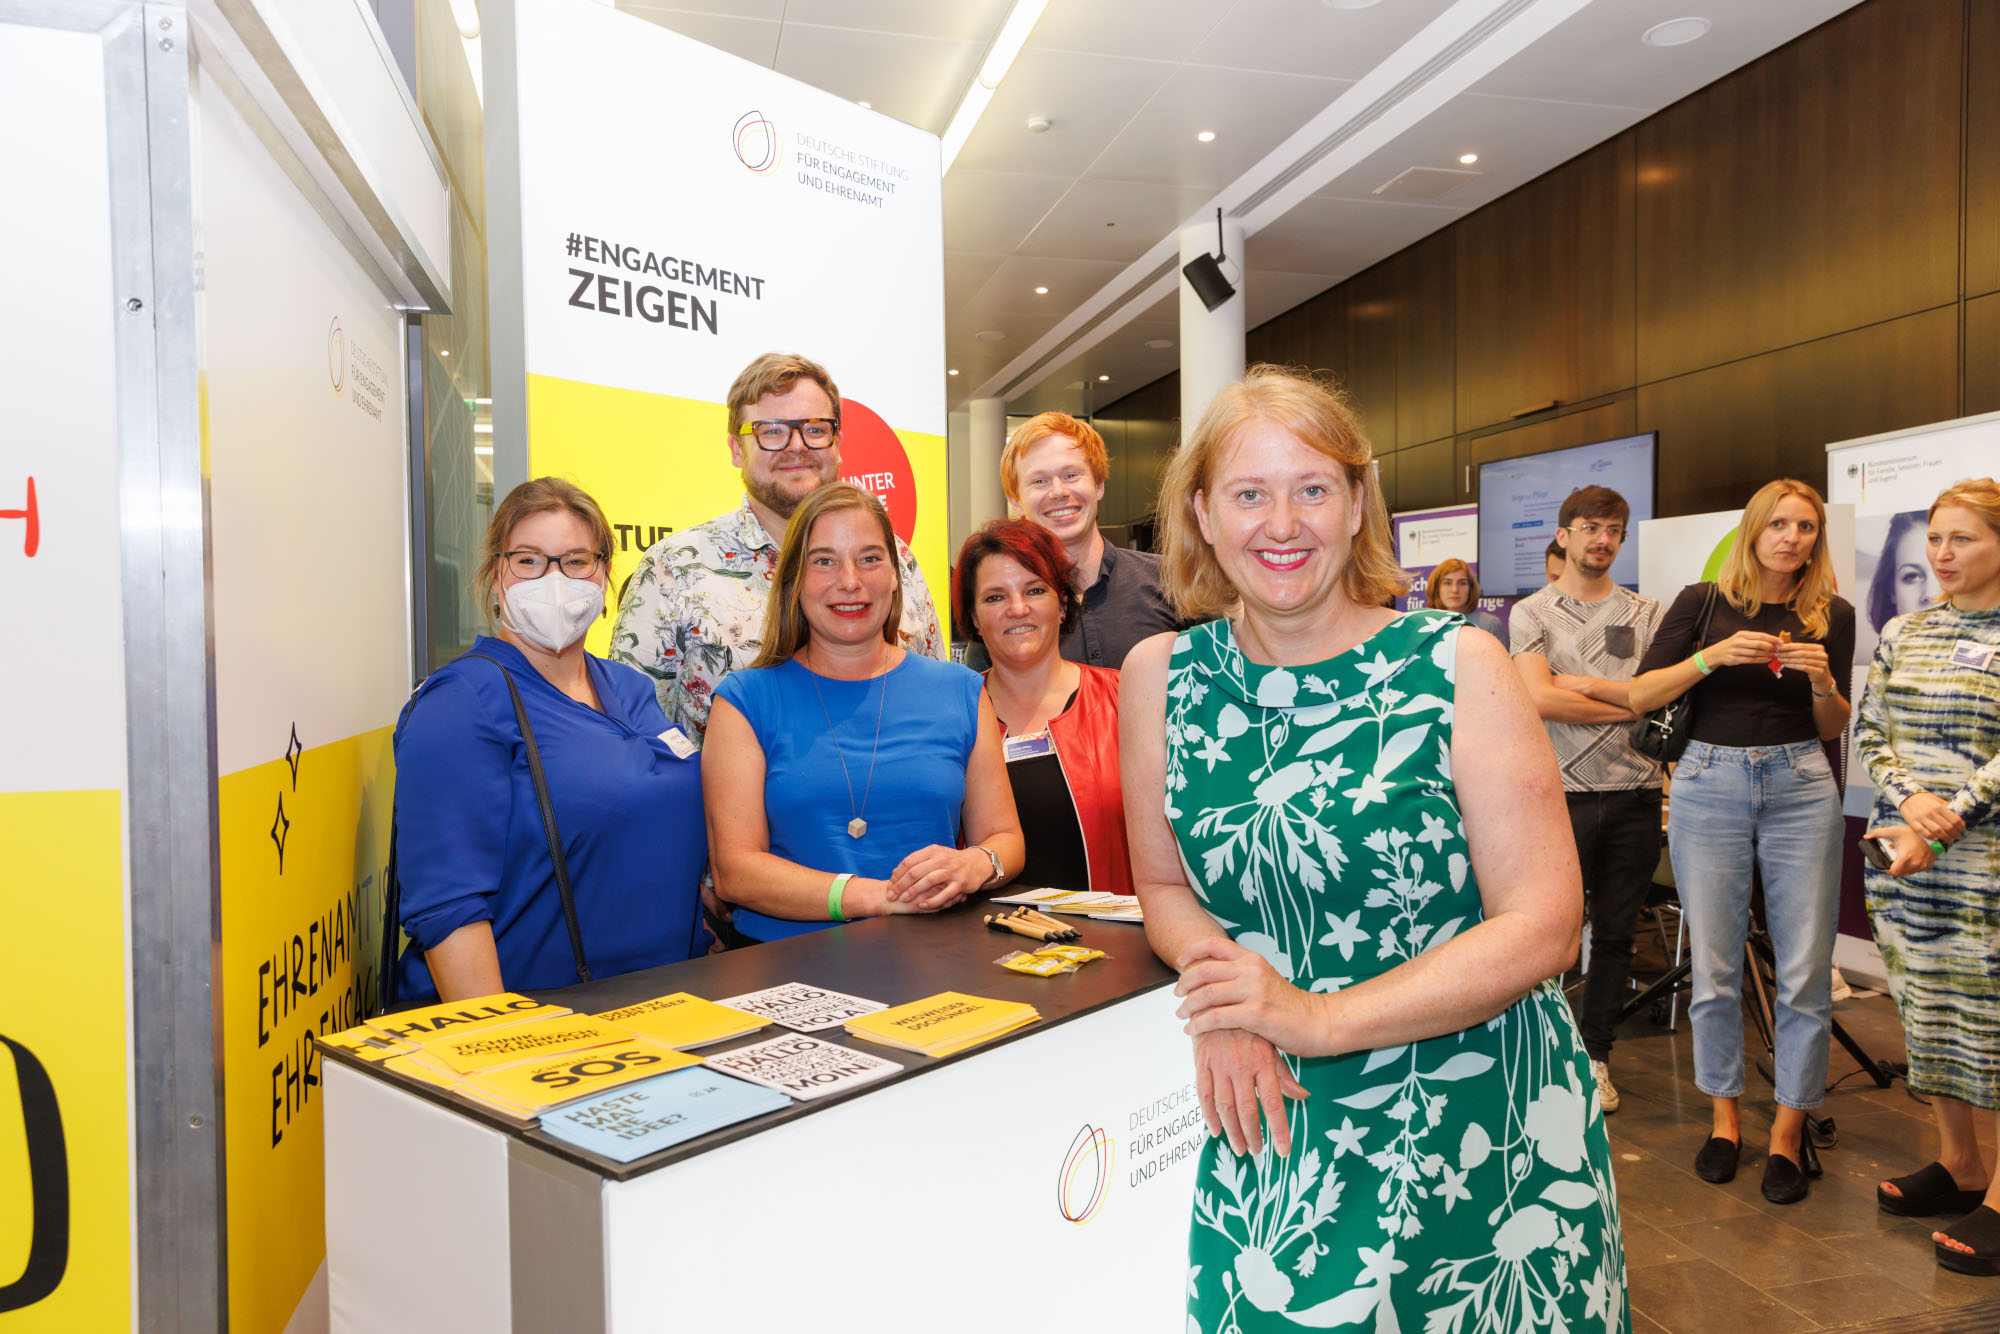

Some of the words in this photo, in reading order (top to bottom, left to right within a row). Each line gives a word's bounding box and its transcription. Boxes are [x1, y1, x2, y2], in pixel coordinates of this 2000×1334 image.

[797, 132, 856, 164] DEUTSCHE
[858, 154, 909, 181] STIFTUNG
[797, 152, 821, 170] FÜR
[822, 161, 896, 194] ENGAGEMENT
[797, 171, 823, 190] UND
[825, 181, 884, 208] EHRENAMT
[565, 232, 766, 300] #ENGAGEMENT
[568, 267, 718, 335] ZEIGEN
[258, 874, 373, 1049] EHRENAMT
[383, 1001, 540, 1038] HALLO
[741, 991, 827, 1012] HALLO
[790, 1009, 866, 1028] HOLA
[531, 1051, 661, 1088] SOS
[723, 1041, 820, 1071] HALLO
[783, 1063, 871, 1091] MOIN
[564, 1091, 650, 1122] HASTE
[581, 1108, 644, 1129] MAL
[1129, 1084, 1191, 1130] DEUTSCHE
[616, 1113, 688, 1140] IDEE?
[1130, 1133, 1154, 1159] FÜR
[1156, 1105, 1204, 1145] ENGAGE
[1130, 1160, 1157, 1187] UND
[1160, 1133, 1202, 1172] EHRENA
